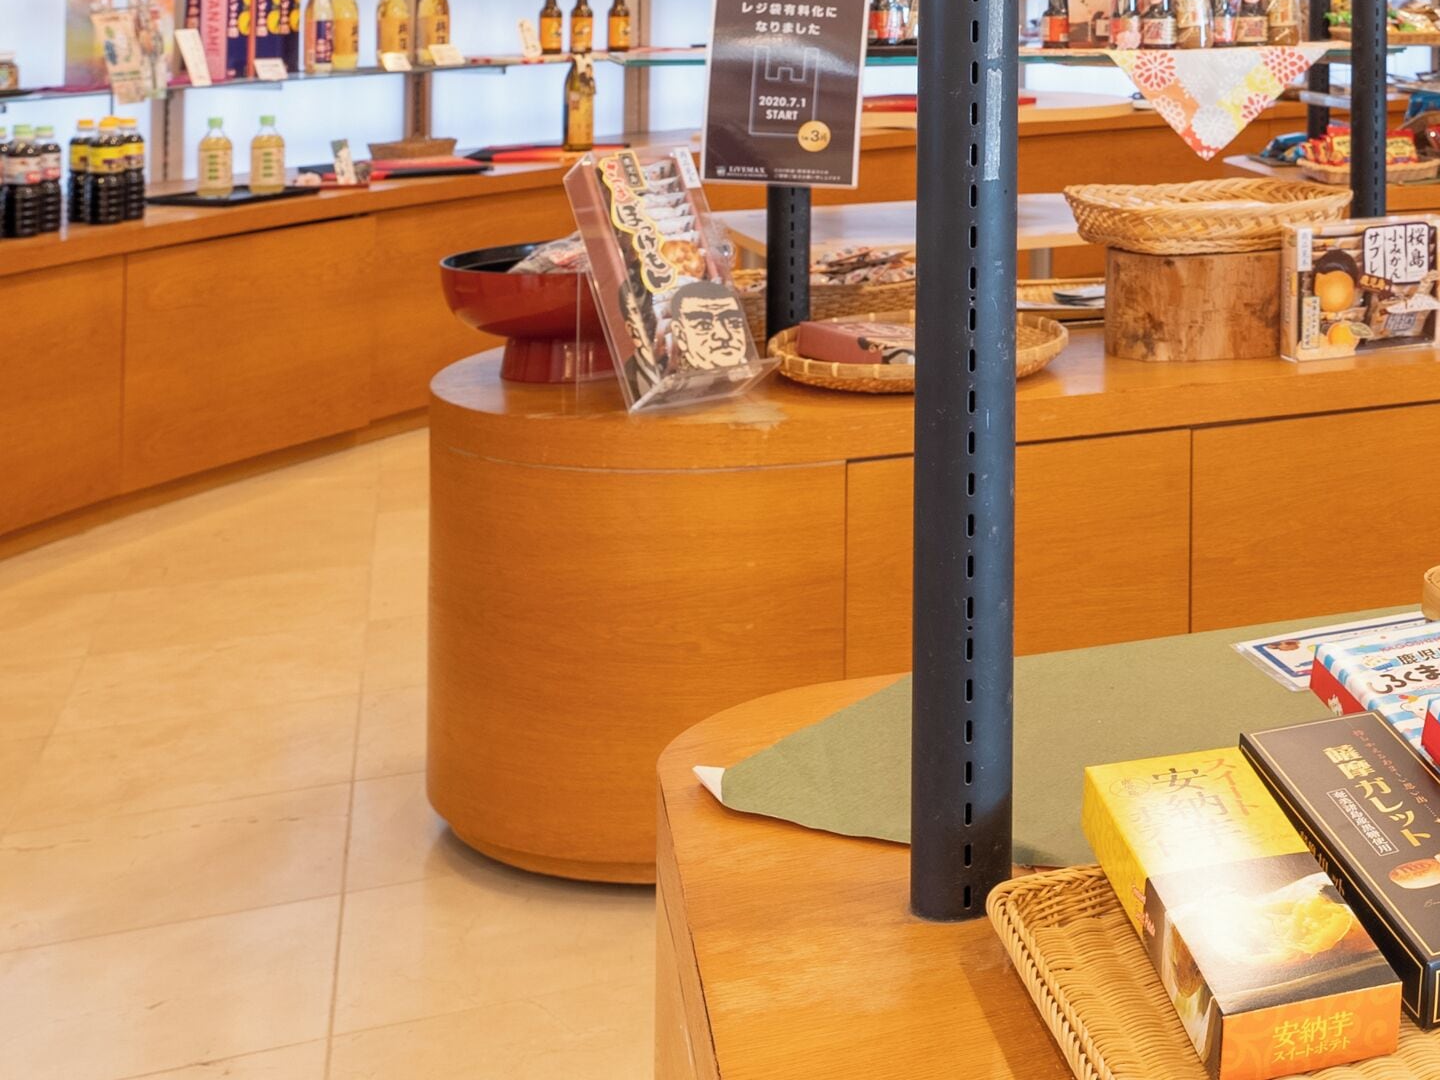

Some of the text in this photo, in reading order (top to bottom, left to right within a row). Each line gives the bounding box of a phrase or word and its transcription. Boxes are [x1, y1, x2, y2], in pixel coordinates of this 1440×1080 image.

[741, 1, 838, 18] レジ袋有料化に
[755, 20, 821, 35] なりました
[758, 95, 807, 108] 2020.7.1
[765, 109, 799, 121] START
[1387, 229, 1403, 280] 小みかん
[1407, 227, 1425, 268] 桜島
[1203, 757, 1259, 817] スイート
[1272, 1010, 1354, 1051] 安納芋
[1271, 1036, 1351, 1064] スイートポテト
